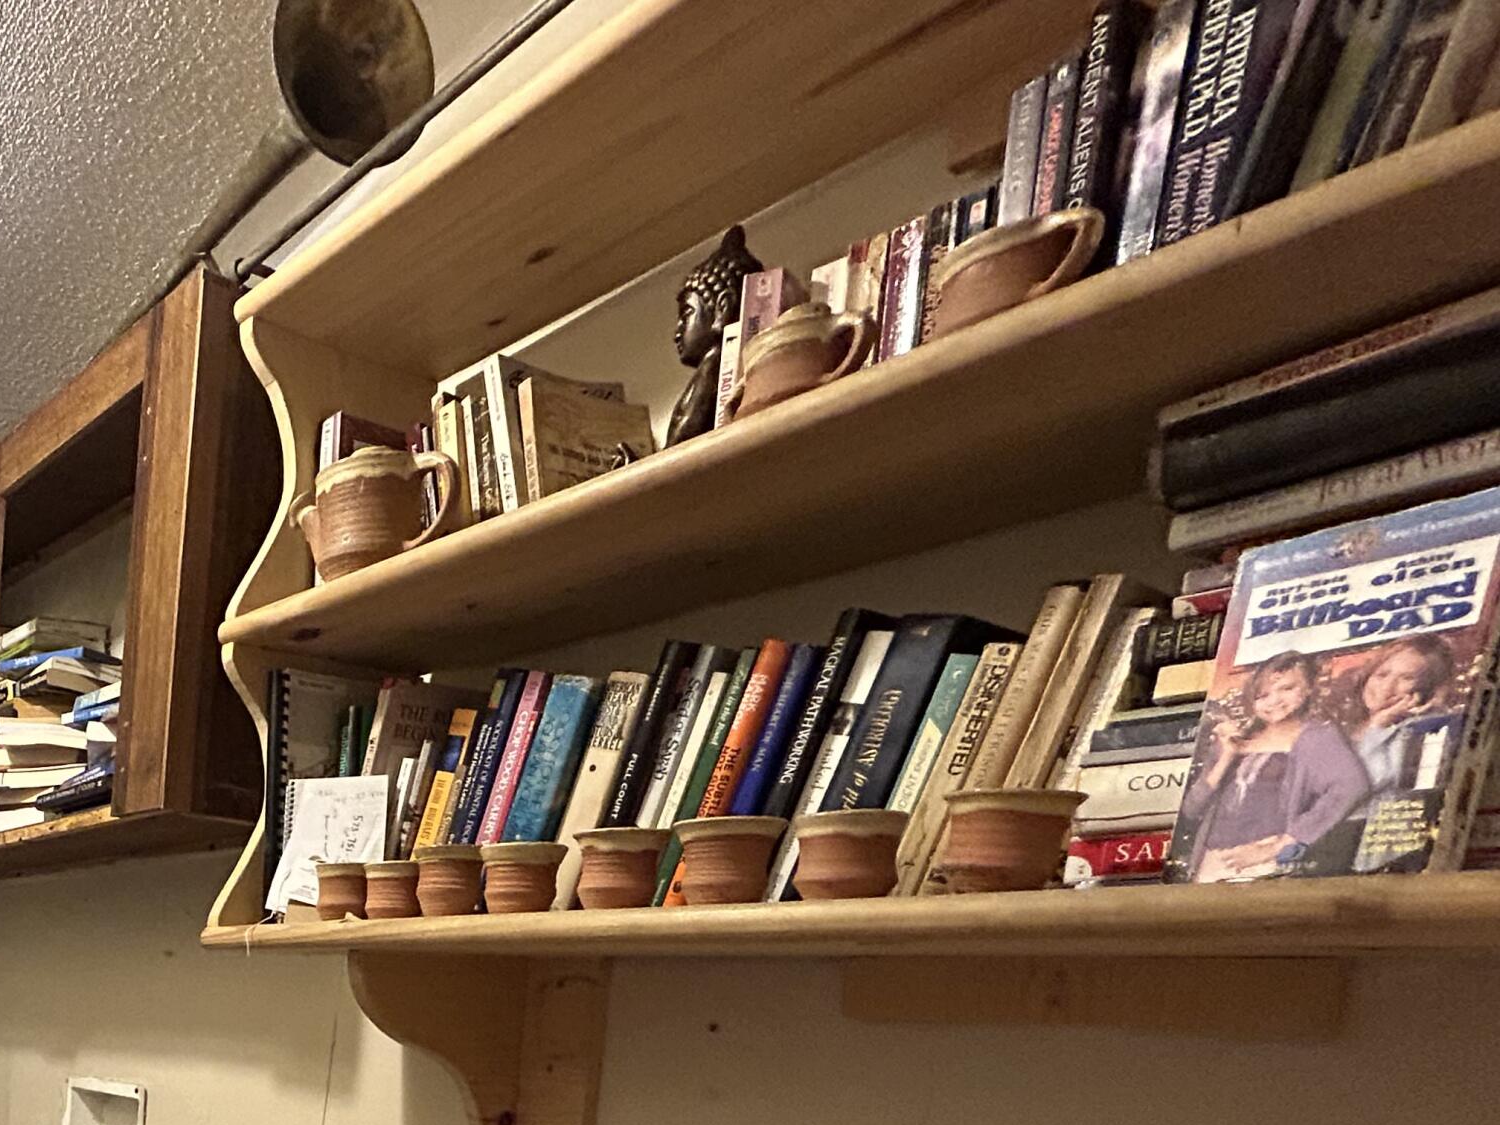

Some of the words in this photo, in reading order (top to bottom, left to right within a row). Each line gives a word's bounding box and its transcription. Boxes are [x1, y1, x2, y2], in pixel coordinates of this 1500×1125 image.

[1079, 13, 1110, 109] ANCIENT
[1192, 0, 1232, 80] FIELD,
[1210, 8, 1257, 128] PATRICIA
[1069, 116, 1097, 193] ALIENS
[1164, 147, 1204, 242] Women's
[1190, 136, 1233, 234] Women's
[1245, 570, 1480, 639] Billboard
[1343, 601, 1473, 641] DAD
[815, 636, 847, 691] MAGICAL
[511, 711, 529, 748] CHOP
[779, 695, 824, 784] PATHWORKING
[858, 689, 903, 768] ASTROLOGY
[948, 664, 1008, 775] DISINHERITED
[483, 720, 503, 768] SOCIOLOGY
[622, 752, 639, 780] FULL
[724, 747, 741, 770] THE
[480, 770, 488, 782] OF
[496, 748, 521, 792] WOOD,
[853, 772, 868, 787] of
[1129, 771, 1185, 791] CON
[458, 788, 468, 809] Learn
[468, 784, 484, 816] MENTAL
[484, 795, 503, 835] CARRY
[610, 781, 628, 820] COURT
